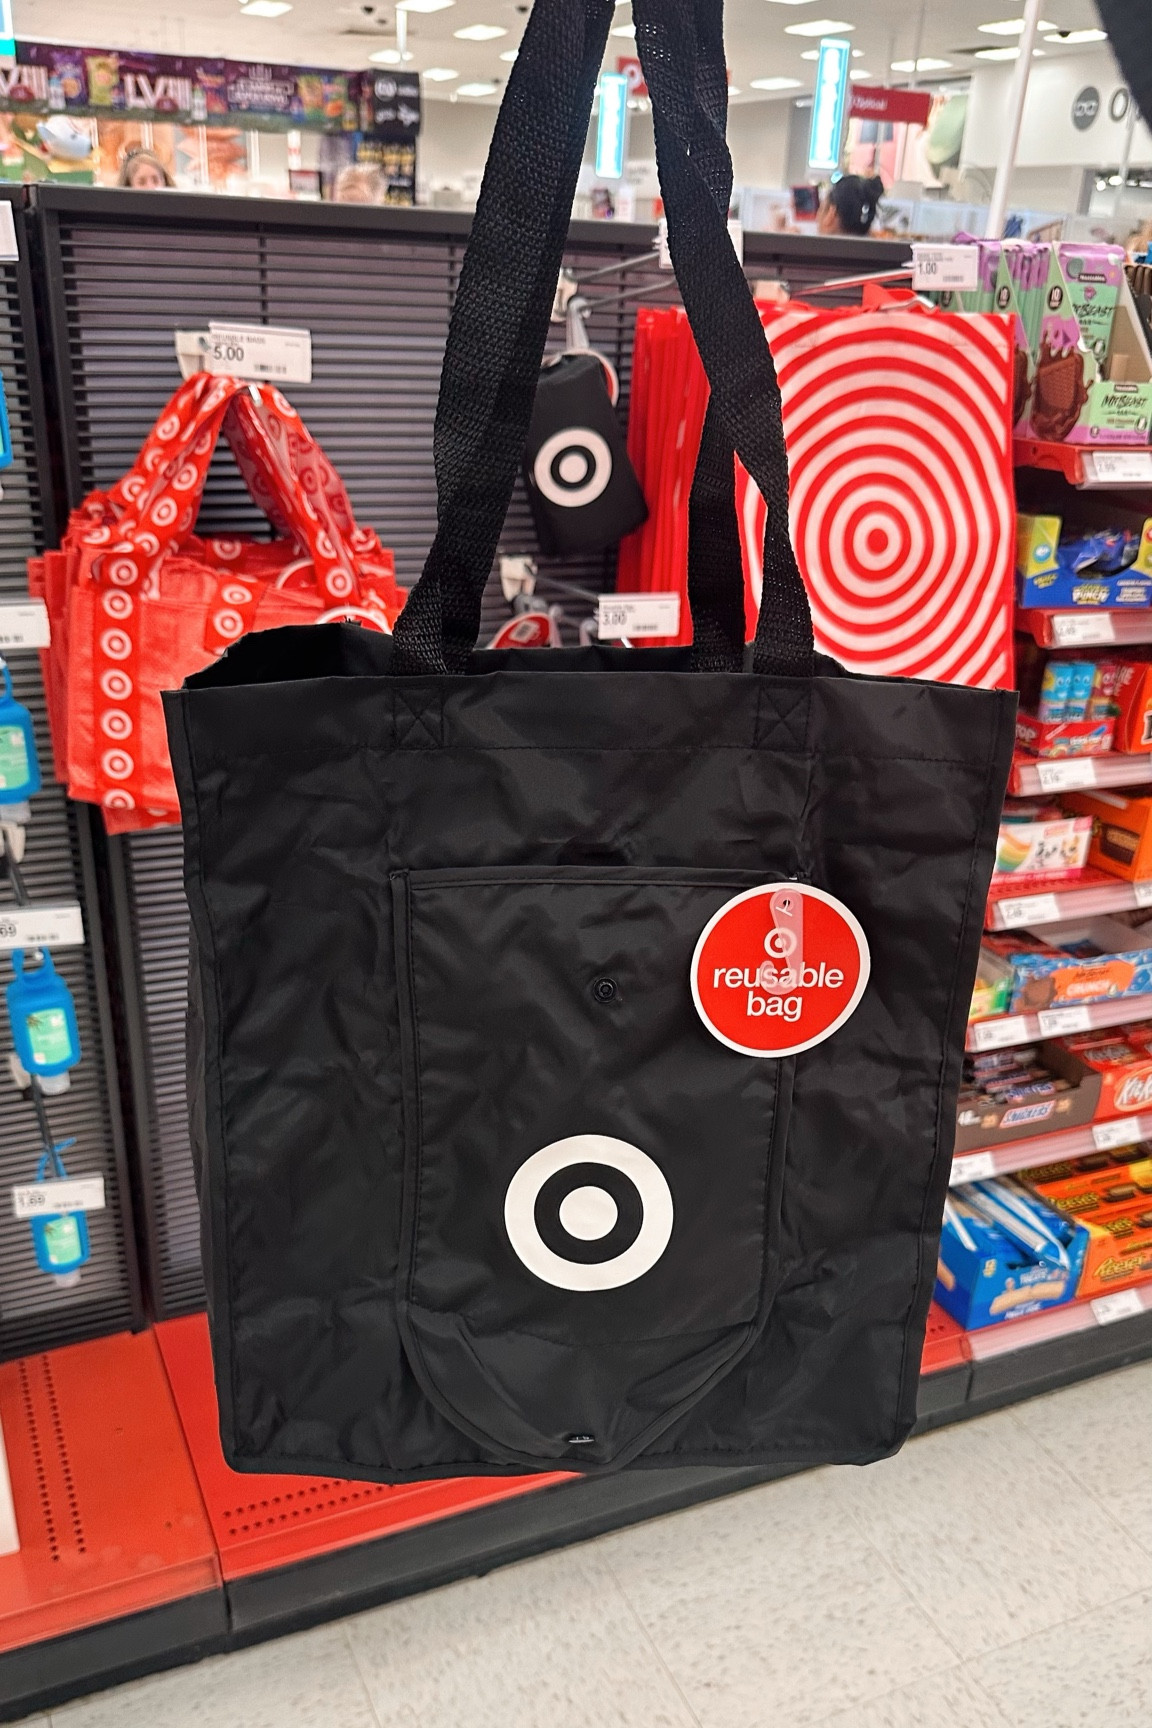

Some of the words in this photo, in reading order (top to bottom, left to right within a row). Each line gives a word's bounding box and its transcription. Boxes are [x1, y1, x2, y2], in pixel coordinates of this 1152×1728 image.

[213, 345, 245, 362] 5.00
[713, 961, 844, 988] reusable
[746, 991, 803, 1023] bag
